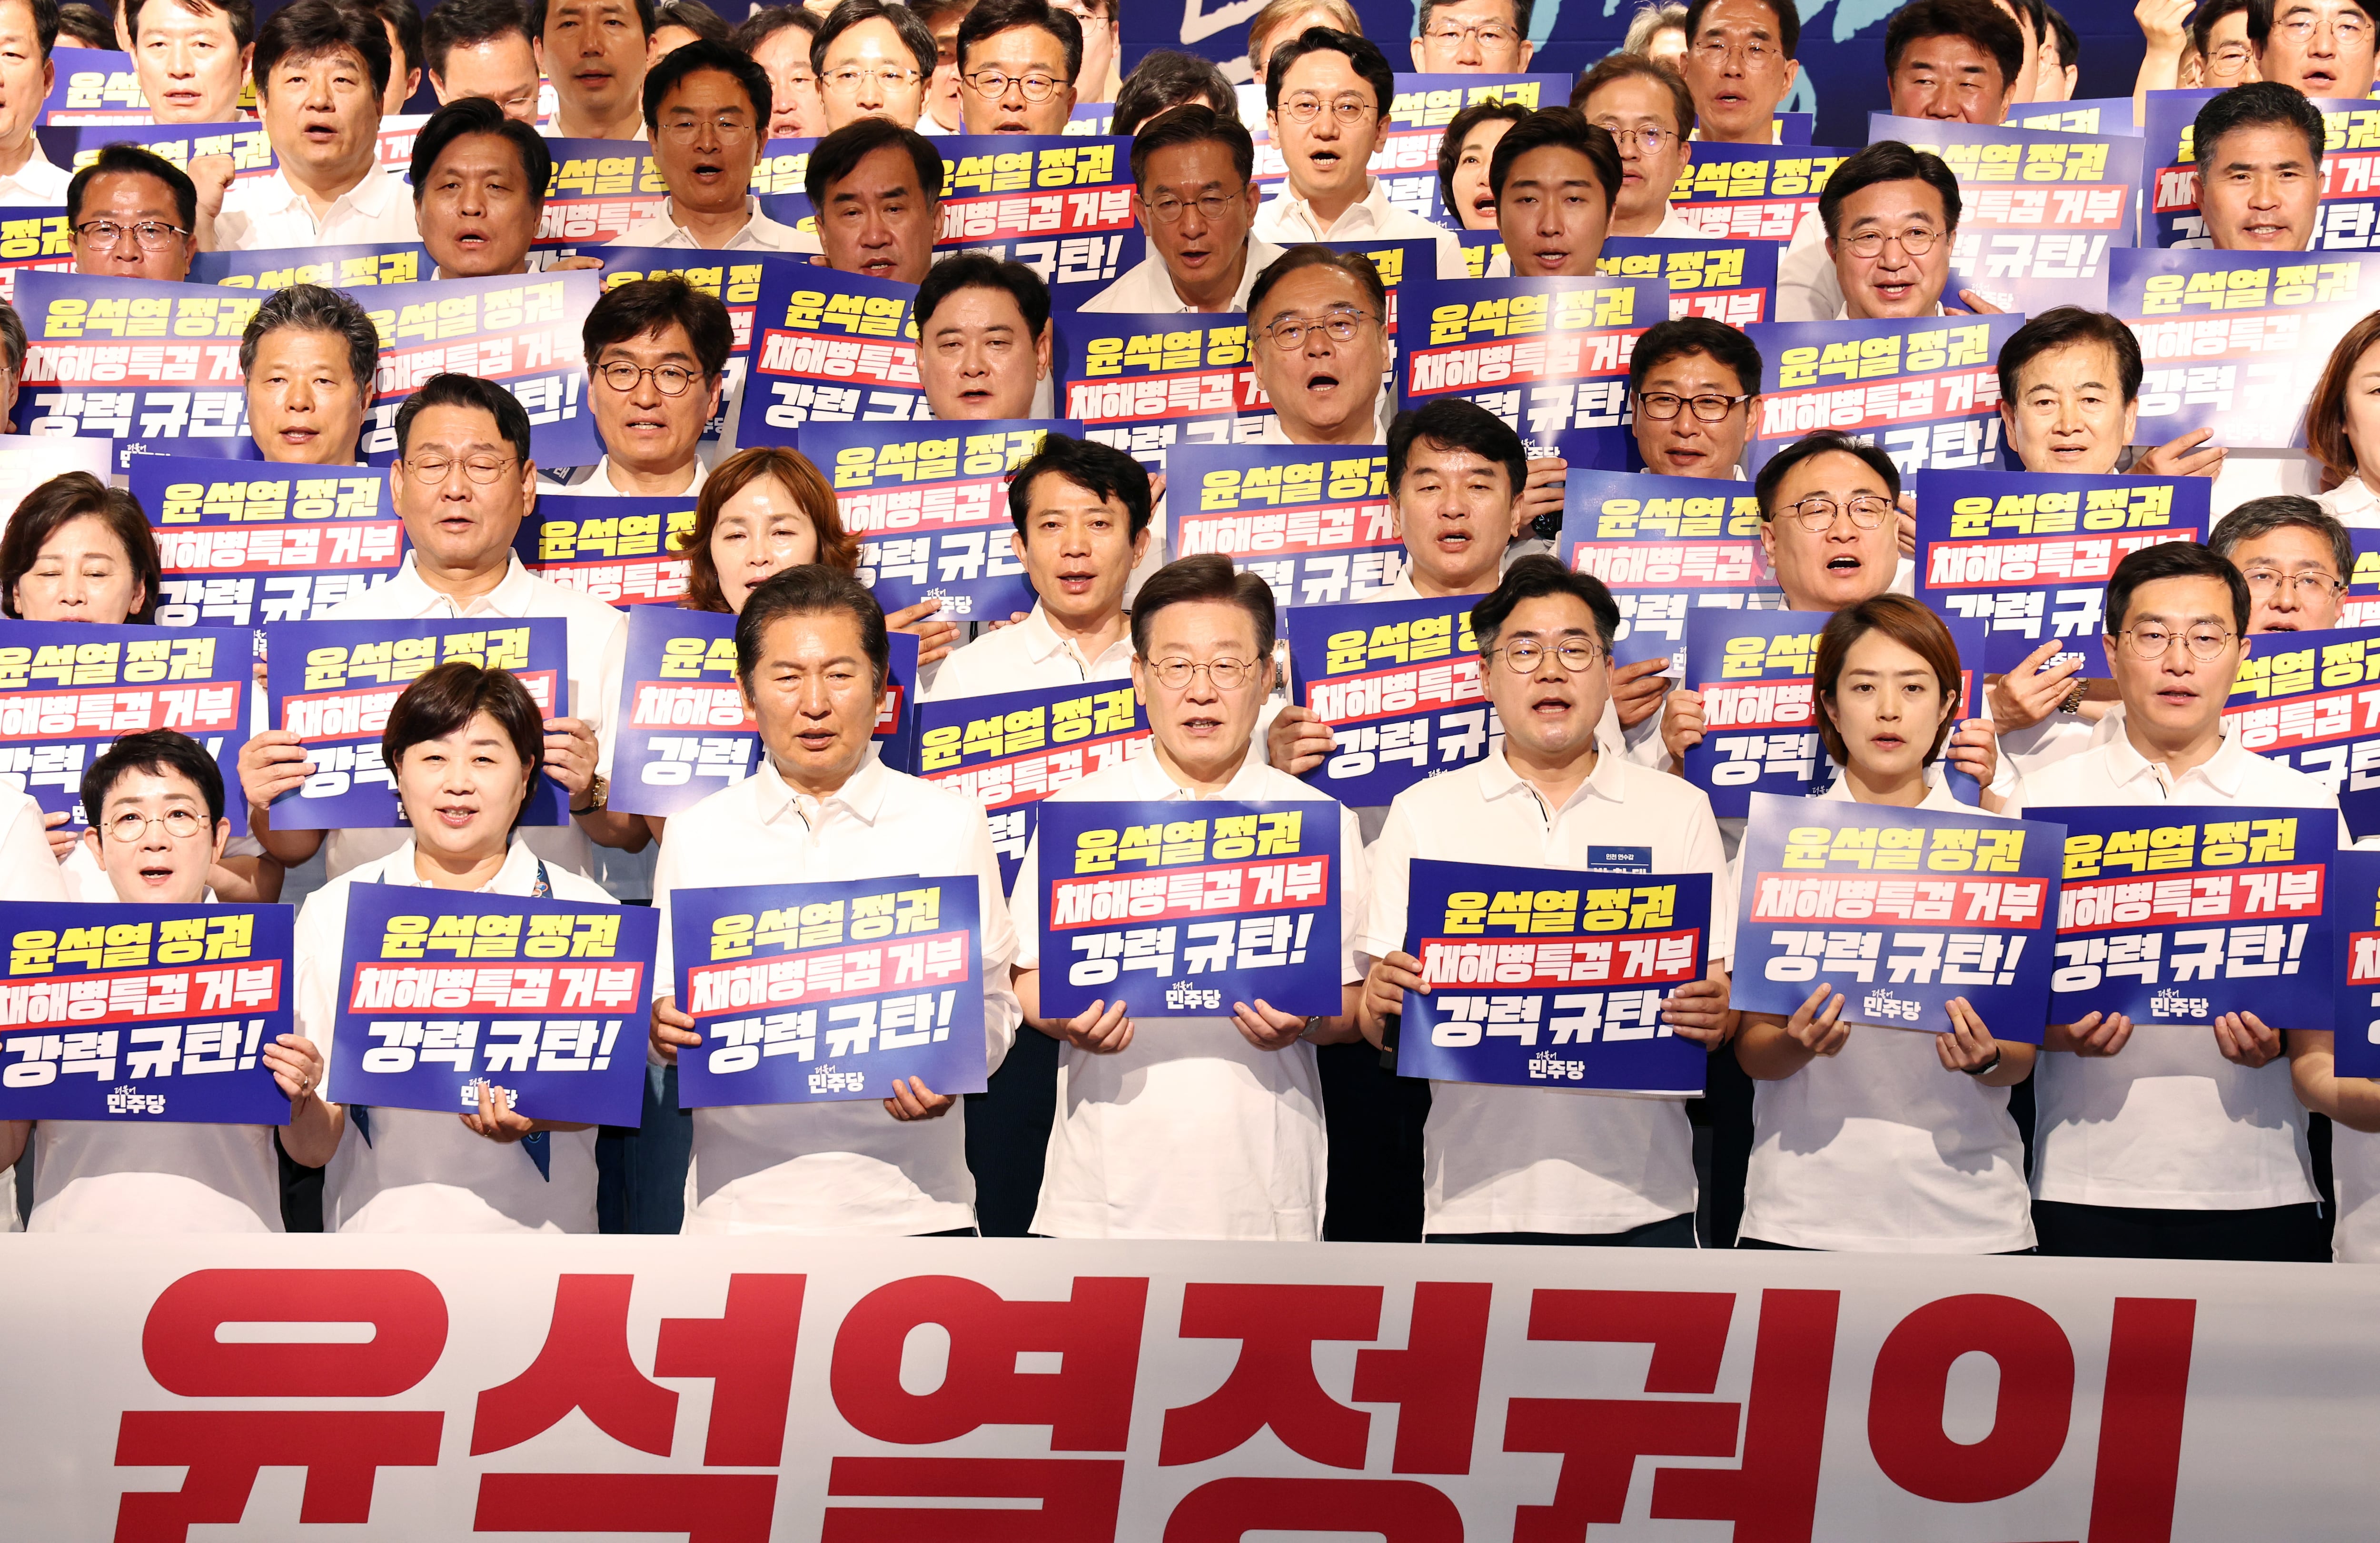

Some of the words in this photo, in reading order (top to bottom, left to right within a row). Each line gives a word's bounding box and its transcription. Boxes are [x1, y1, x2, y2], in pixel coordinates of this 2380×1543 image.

[1389, 89, 1462, 128] 석열
[545, 159, 635, 197] 석열
[1037, 144, 1115, 187] 정권
[2023, 144, 2109, 181] 정권
[940, 196, 1063, 239] 해병특검
[1068, 189, 1131, 231] 거부
[2053, 190, 2121, 223] 거부
[1665, 248, 1745, 289] 정권
[1987, 234, 2108, 278] 규탄!
[483, 281, 564, 330] 정권
[2142, 268, 2271, 315] 윤석열
[2272, 261, 2361, 306] 정권
[44, 299, 172, 337] 윤석열
[174, 299, 261, 337] 정권
[784, 290, 905, 337] 윤석열
[1429, 292, 1552, 345] 윤석열
[1553, 287, 1636, 330] 정권
[23, 345, 201, 381] 채해병특검
[205, 347, 245, 380] 거
[375, 338, 514, 393] 해병특검
[1085, 329, 1203, 377] 윤석열
[1411, 344, 1579, 392] 채해병특검
[1779, 335, 1902, 388] 윤석열
[1905, 323, 1990, 372] 정권
[30, 392, 136, 438] 강력
[764, 381, 862, 428] 강력
[1069, 373, 1234, 420] 채해병특검
[1761, 381, 1934, 435] 채해병특검
[2137, 365, 2237, 418] 강력
[834, 438, 959, 489] 윤석열
[1200, 462, 1324, 511] 윤석열
[161, 480, 289, 523] 윤석열
[292, 478, 382, 519] 정권
[1597, 497, 1726, 538] 윤석열
[1950, 491, 2080, 538] 윤석열
[2083, 486, 2174, 530] 정권
[326, 526, 397, 565] 거부
[538, 514, 660, 561] 윤석열
[1182, 507, 1356, 555] 채해병특검
[1930, 538, 2112, 585] 채해병특검
[155, 578, 255, 627] 강력
[921, 596, 972, 614] 주당
[927, 587, 946, 597] 더불어
[0, 642, 120, 689] 윤석열
[124, 637, 216, 683] 정권
[304, 637, 436, 690] 윤석열
[660, 637, 738, 678] 윤석
[1326, 615, 1451, 674] 윤석열
[1722, 634, 1823, 678] 윤석
[2234, 649, 2315, 699] 석열
[0, 692, 153, 735] 해병특검
[158, 687, 234, 728] 거부
[287, 692, 400, 738] 채해병
[633, 686, 744, 727] 채해병
[1702, 685, 1813, 725] 채해병
[922, 706, 1045, 772] 윤석열
[1051, 687, 1134, 743] 정권
[1327, 717, 1428, 779] 강력
[642, 737, 753, 787] 강력
[1712, 733, 1819, 786] 강력
[1074, 819, 1208, 874] 윤석열
[1211, 810, 1303, 859] 정권
[1782, 827, 1925, 869] 윤석열
[1927, 828, 2026, 872] 정권
[2063, 825, 2196, 879] 윤석열
[2201, 817, 2298, 866] 정권
[1054, 869, 1242, 925] 채해병특검
[1248, 861, 1322, 905] 거부
[1443, 889, 1579, 934] 윤석열
[1583, 885, 1676, 932] 정권
[1755, 877, 1957, 920] 채해병특검
[1963, 882, 2041, 922] 거부
[2239, 870, 2318, 913] 거부
[9, 922, 153, 975] 윤석열
[157, 914, 254, 963] 정권
[380, 915, 523, 958] 윤석열
[524, 915, 621, 957] 정권
[710, 900, 844, 961] 윤석열
[850, 886, 940, 940] 정권
[1069, 926, 1177, 986] 강력
[1184, 913, 1314, 975] 규탄!
[1421, 941, 1613, 983] 채해병특검
[1618, 935, 1694, 978] 거부
[1764, 930, 1883, 983] 강력
[1886, 932, 2027, 986] 규탄!
[2051, 932, 2163, 993] 강력
[2170, 923, 2309, 982] 규탄!
[195, 966, 274, 1010] 거부
[353, 967, 554, 1008] 채해병특검
[558, 968, 635, 1007] 거부
[691, 948, 881, 1013] 채해병특검
[888, 936, 962, 984] 거부
[1171, 981, 1193, 990] 더불어
[1872, 988, 1893, 999] 더불어
[2158, 988, 2179, 998] 더불어
[1166, 989, 1221, 1010] 민주당
[1431, 995, 1543, 1047] 강력
[1864, 996, 1921, 1022] 민주당
[2150, 996, 2209, 1018] 민주당
[2, 1030, 119, 1088] 강력
[126, 1019, 265, 1079] 규탄!
[361, 1020, 480, 1074] 강력
[483, 1020, 623, 1072] 규탄!
[708, 1009, 817, 1074] 강력
[825, 990, 956, 1058] 규탄!
[1536, 1051, 1557, 1060] 더불어
[114, 1085, 136, 1095] 더불어
[808, 1072, 864, 1094] 민주당
[814, 1064, 836, 1074] 더불어
[1528, 1059, 1585, 1080] 민주당
[107, 1094, 165, 1115] 민주당
